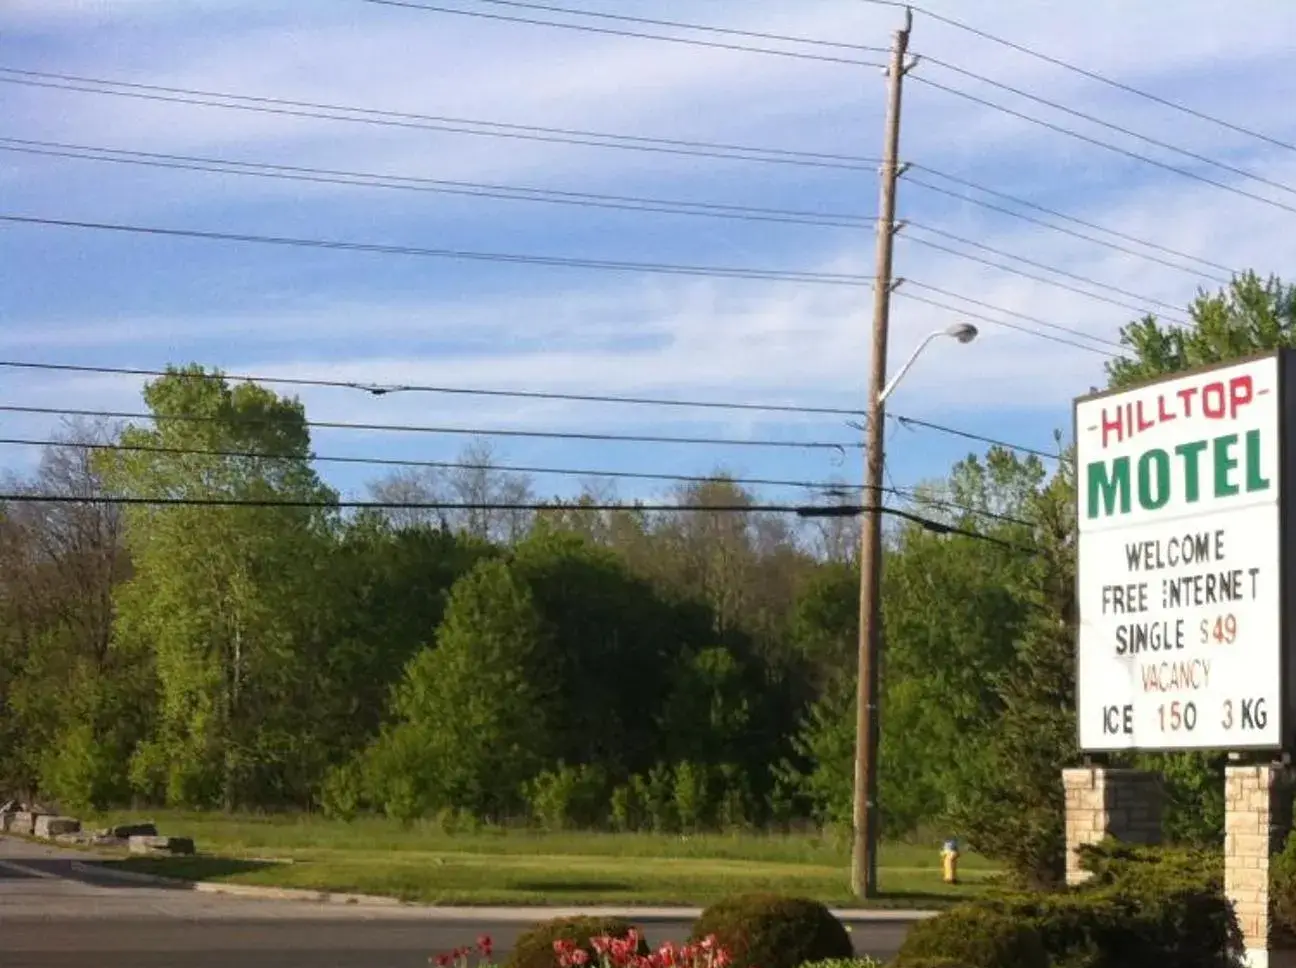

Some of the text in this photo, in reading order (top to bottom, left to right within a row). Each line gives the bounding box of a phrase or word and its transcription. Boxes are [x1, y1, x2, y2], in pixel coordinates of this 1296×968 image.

[1102, 374, 1253, 448] HILLTOP
[1087, 429, 1270, 519] MOTEL
[1126, 530, 1225, 571] WELCOME
[1102, 568, 1260, 614] FREE INTERNET
[1115, 620, 1185, 655] SINGLE
[1141, 659, 1211, 692] VACANCY
[1103, 705, 1133, 735] ICE
